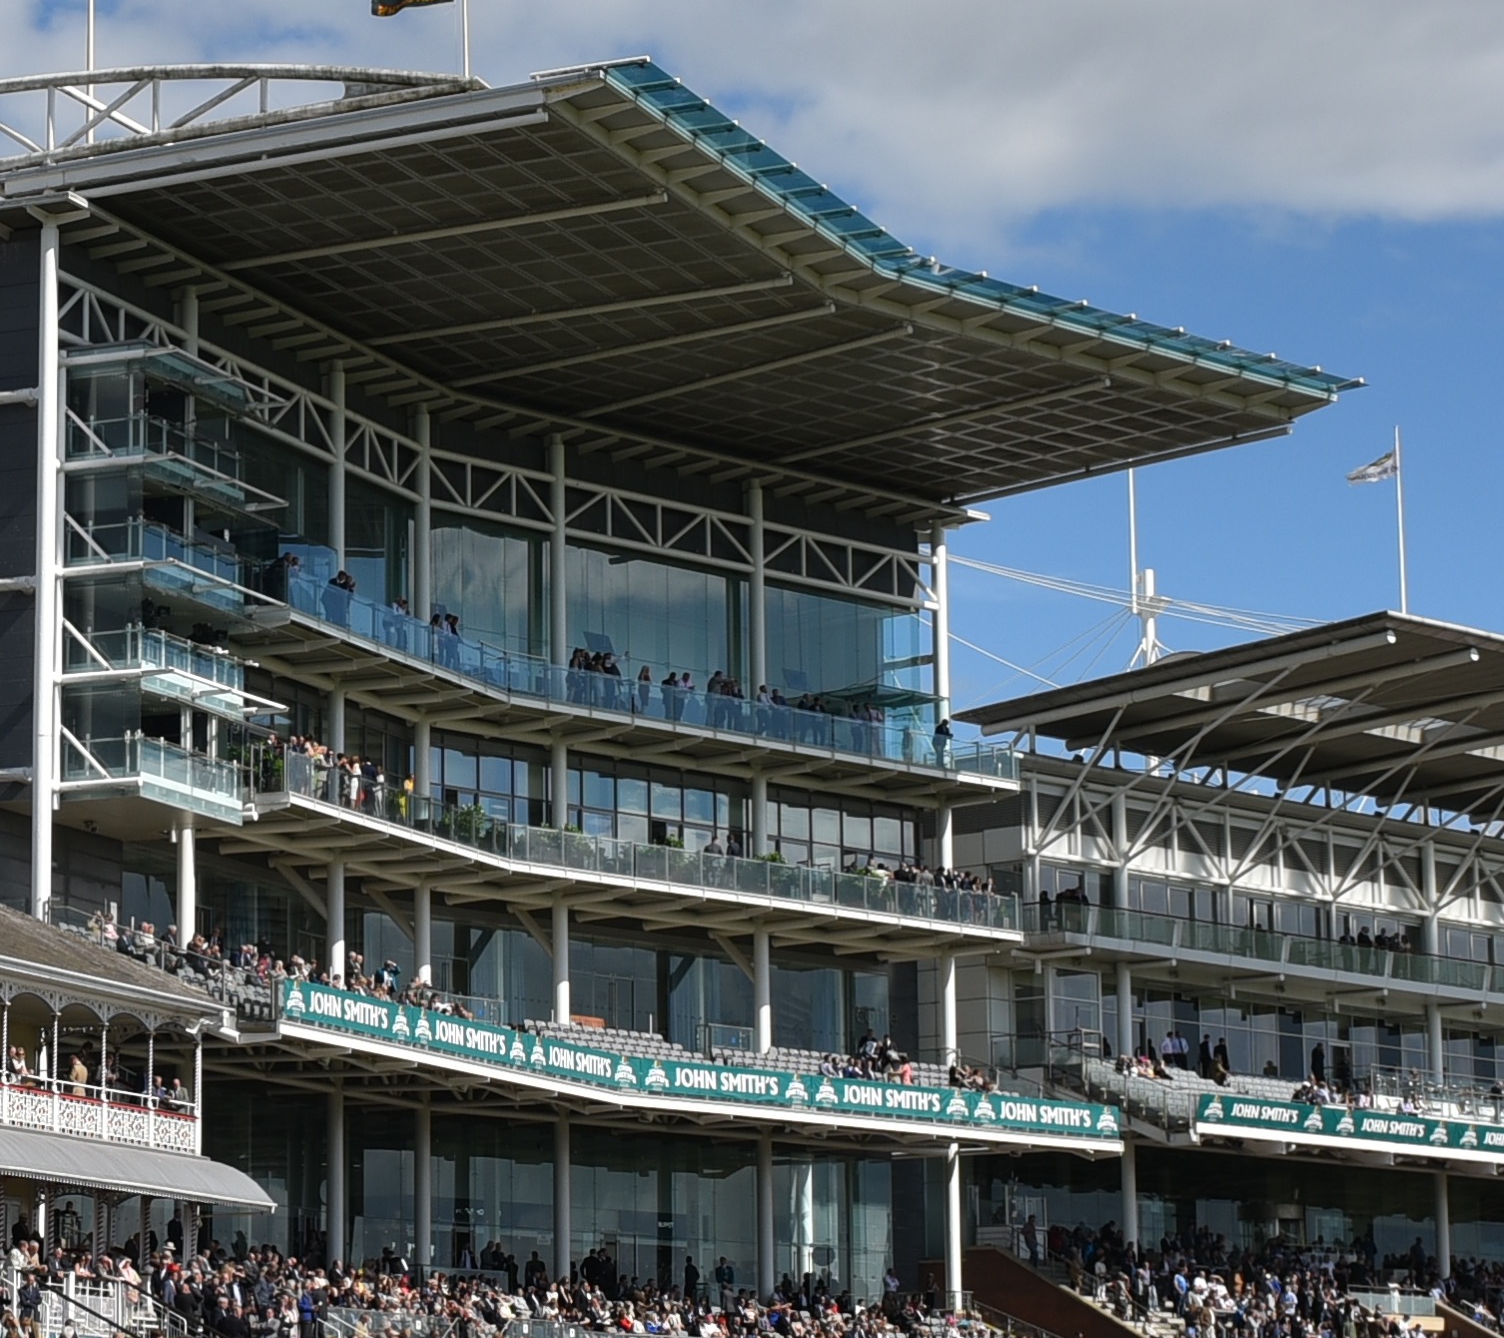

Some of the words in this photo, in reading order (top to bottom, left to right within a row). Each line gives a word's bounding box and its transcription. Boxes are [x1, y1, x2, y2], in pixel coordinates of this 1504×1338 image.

[309, 990, 342, 1019] JOHN
[344, 998, 388, 1029] SMITH'S
[435, 1019, 464, 1046] JOHN
[466, 1027, 506, 1055] SMITH'S
[549, 1045, 574, 1070] JOHN
[576, 1052, 612, 1078] SMITH'S
[675, 1067, 717, 1090] JOHN
[720, 1072, 779, 1096] SMITH'S
[843, 1084, 882, 1106] JOHN
[885, 1089, 941, 1112] SMITH'S
[1000, 1101, 1037, 1122] JOHN
[1039, 1105, 1092, 1128] SMITH'S
[1231, 1103, 1261, 1120] JOHN
[1261, 1106, 1299, 1123] SMITH'S
[1361, 1118, 1389, 1134] JOHN
[1389, 1121, 1425, 1137] SMITH'S
